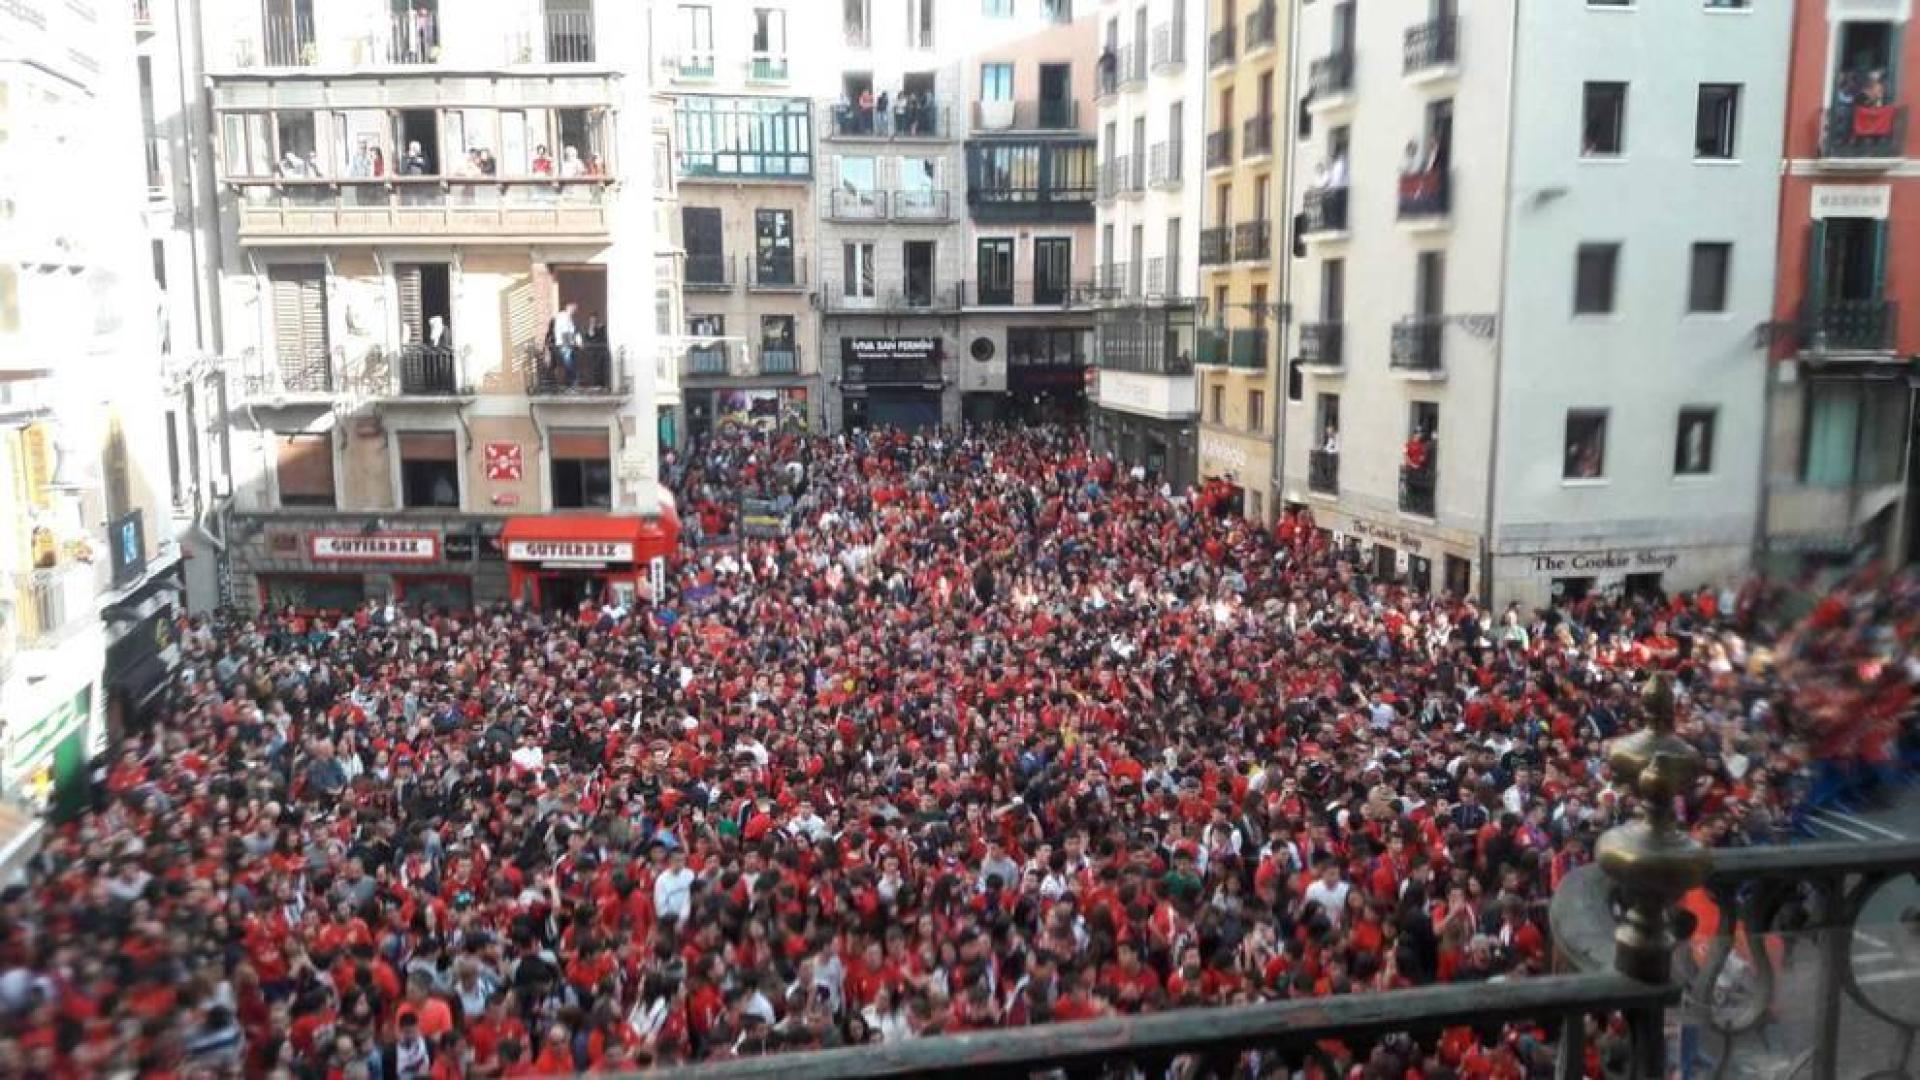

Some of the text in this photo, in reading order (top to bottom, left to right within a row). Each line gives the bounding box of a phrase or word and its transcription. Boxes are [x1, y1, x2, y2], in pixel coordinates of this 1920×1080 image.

[331, 539, 418, 552] GUTIERREZ
[526, 543, 617, 556] GUTIERREZ
[1532, 550, 1677, 571] The Cookie Shop
